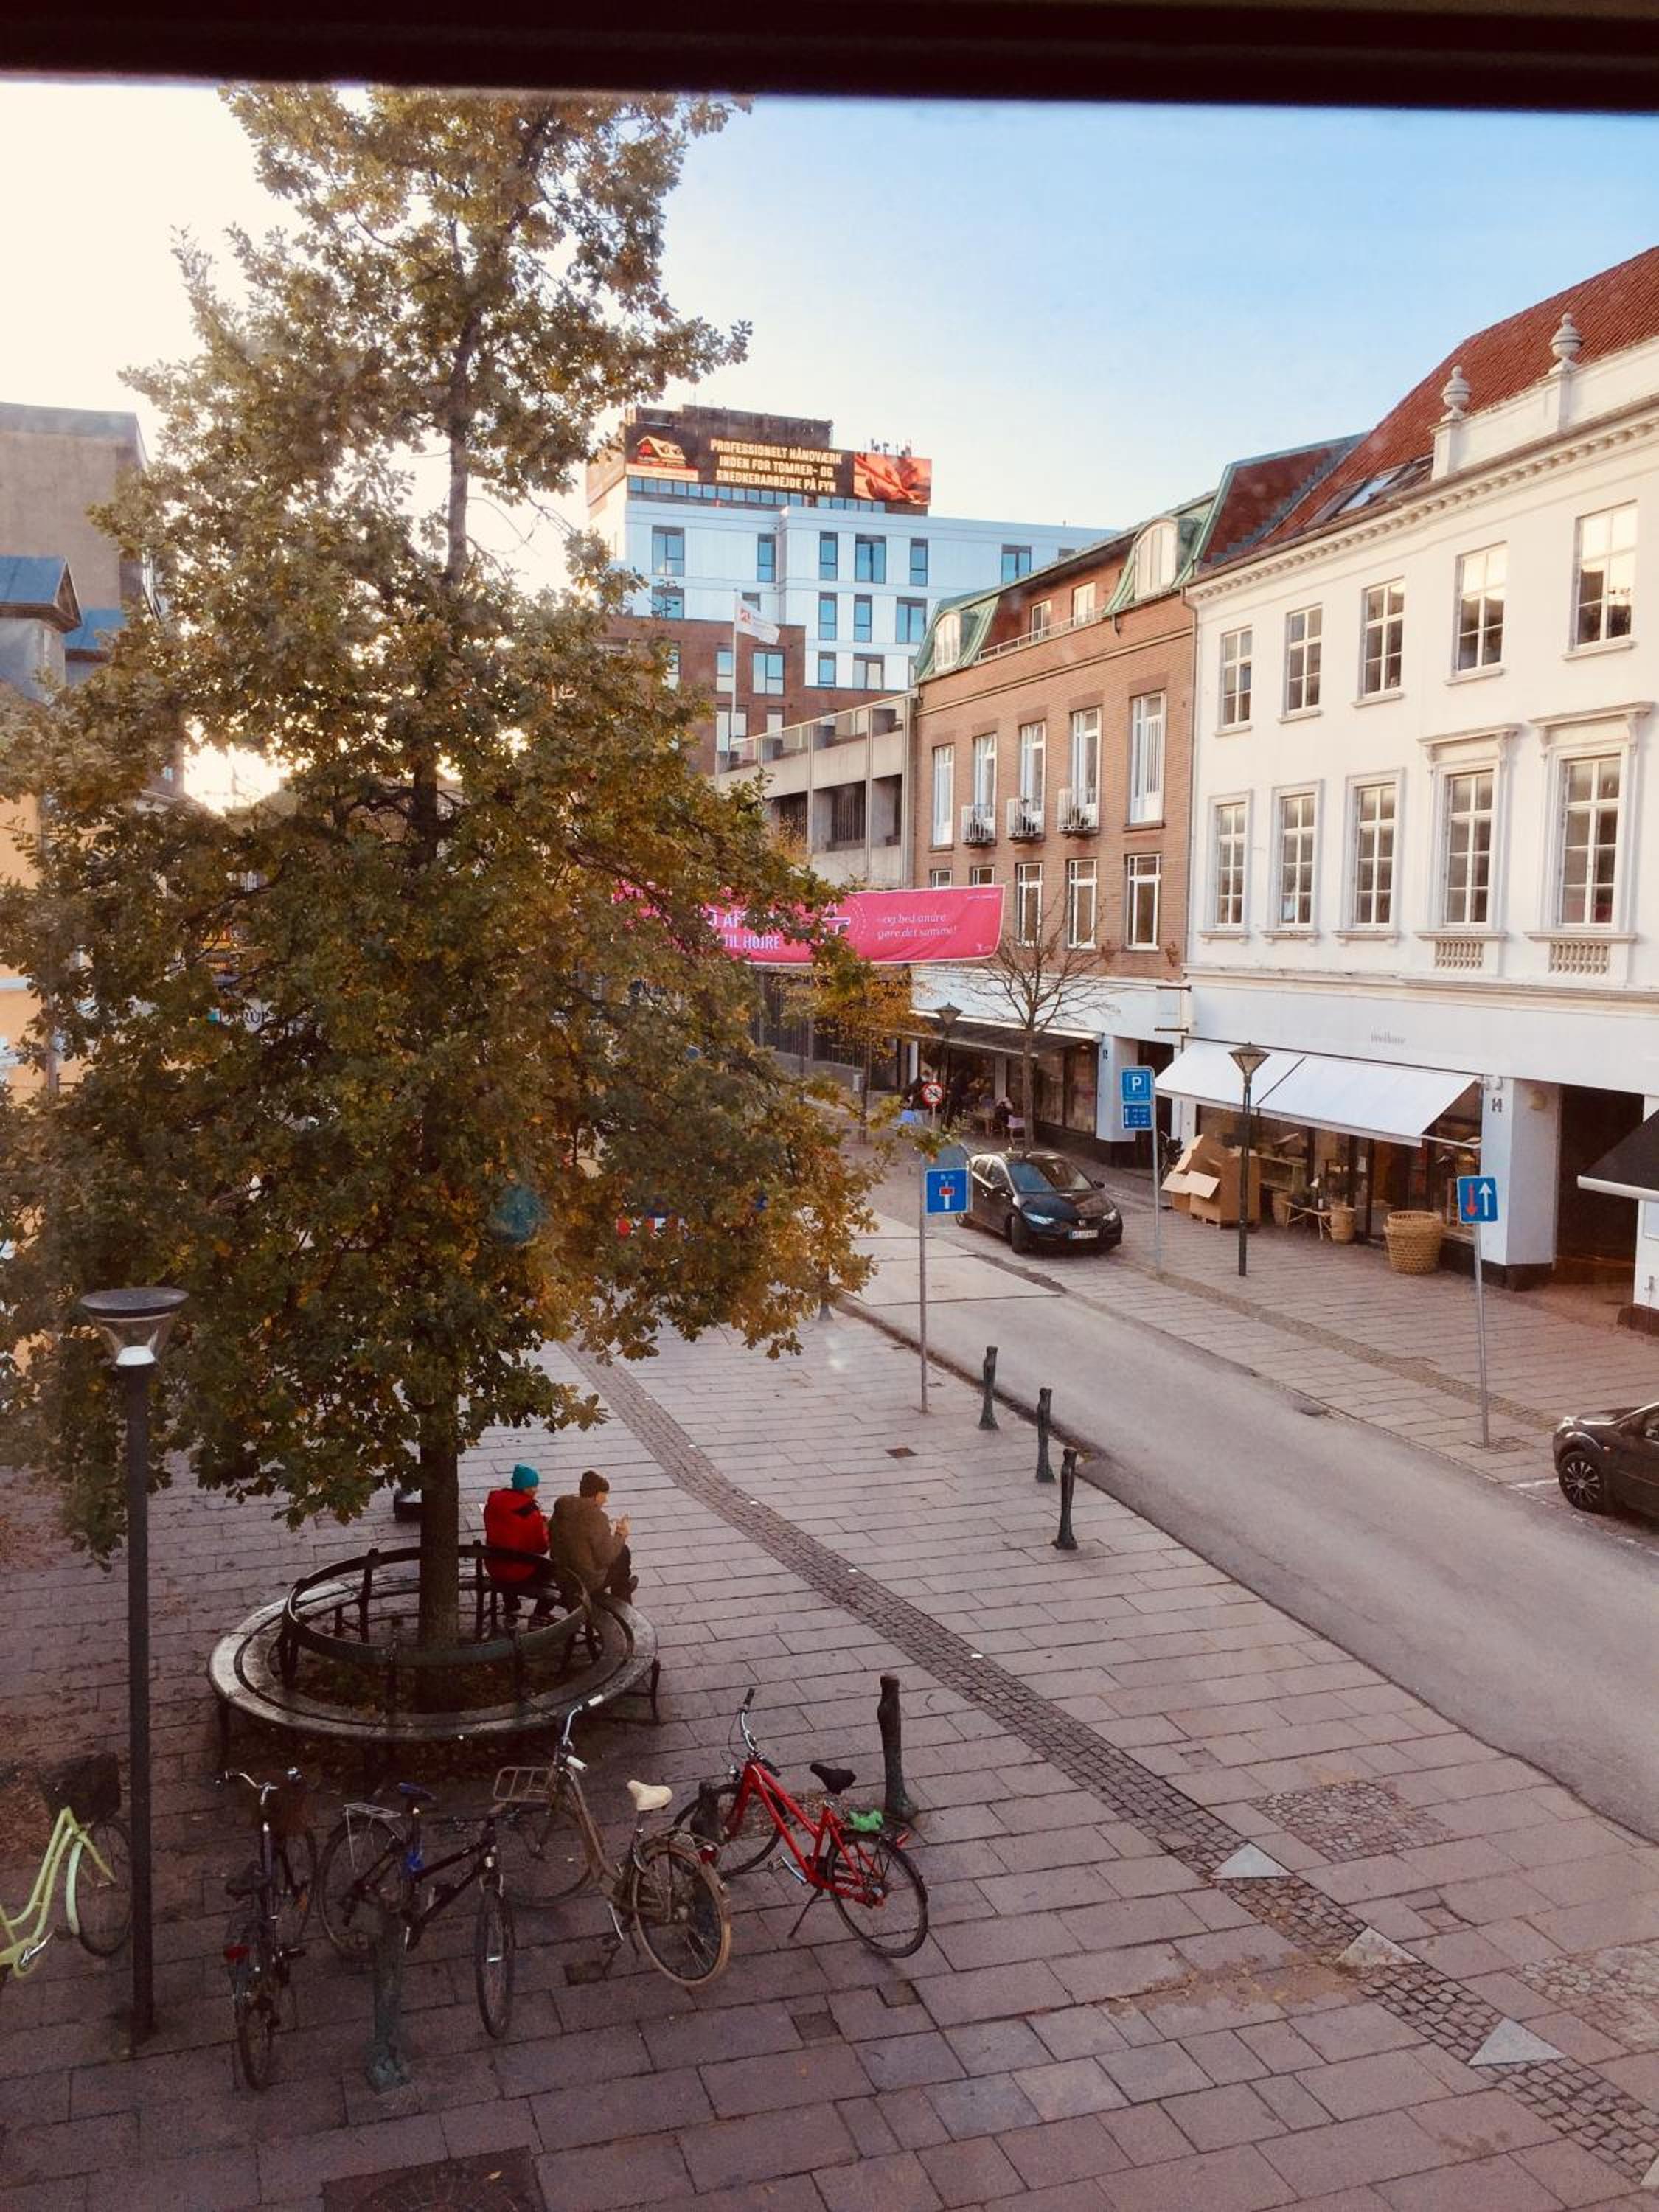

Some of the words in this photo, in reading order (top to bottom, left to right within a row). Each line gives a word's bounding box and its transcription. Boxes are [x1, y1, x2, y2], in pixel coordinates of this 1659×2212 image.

[710, 438, 788, 459] PROFESSIONELT
[789, 447, 843, 465] HÅNDVÆRK
[719, 455, 750, 469] INDEN
[751, 459, 771, 471] FOR
[820, 465, 834, 478] OG
[804, 476, 817, 490] PÅ
[818, 479, 837, 493] FYN
[723, 934, 739, 948] TIL
[1132, 1076, 1142, 1091] P
